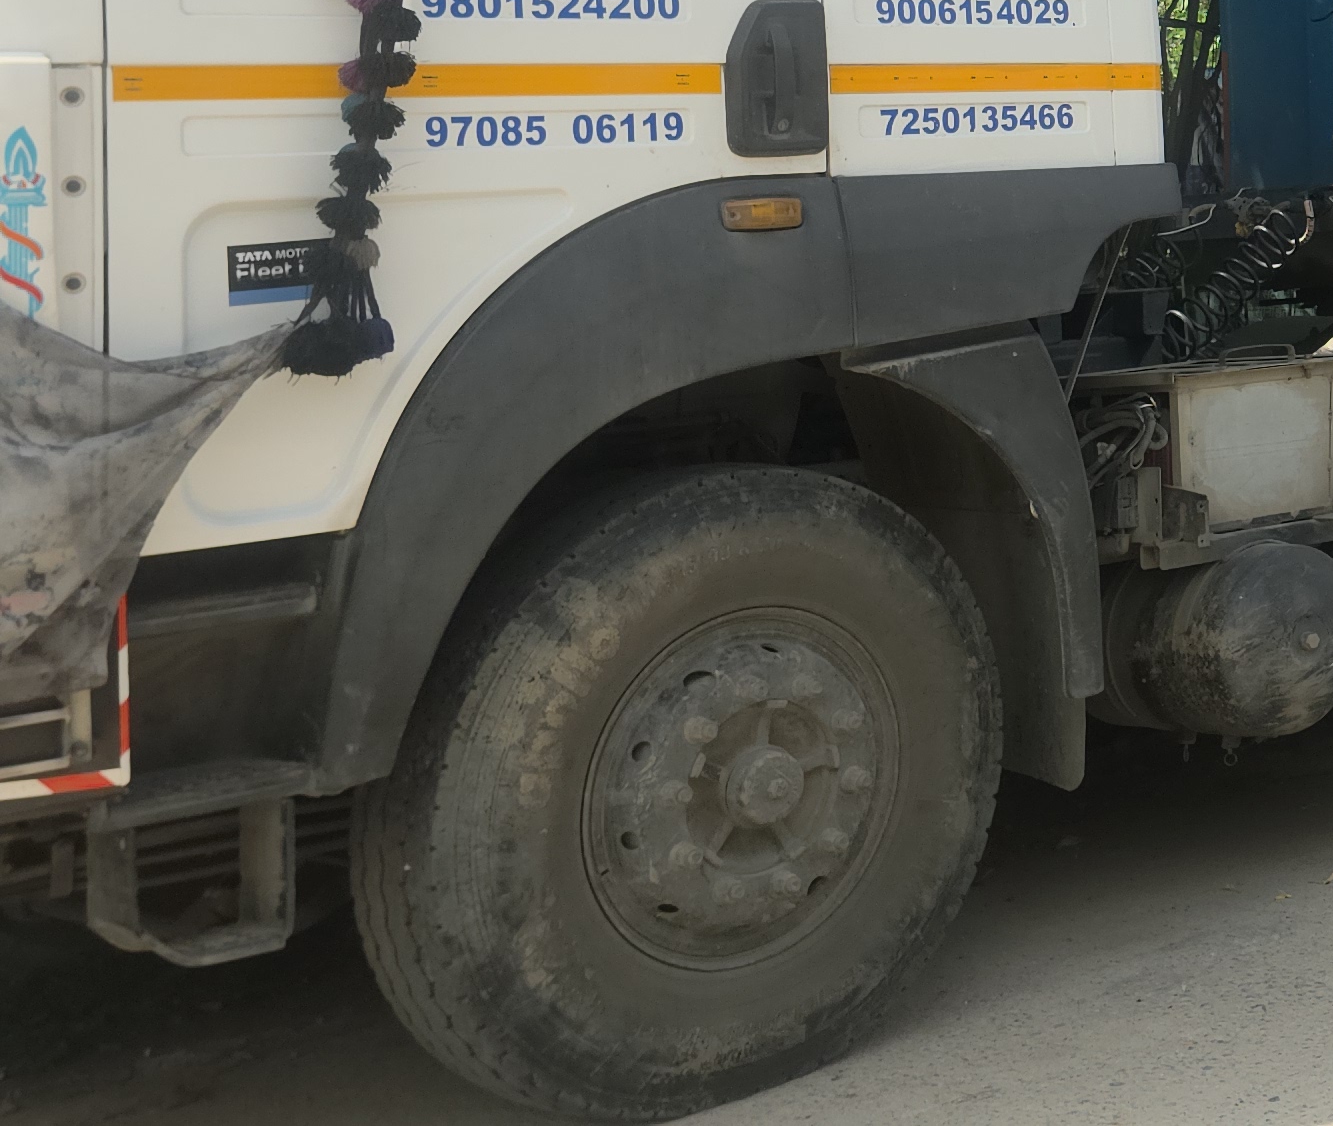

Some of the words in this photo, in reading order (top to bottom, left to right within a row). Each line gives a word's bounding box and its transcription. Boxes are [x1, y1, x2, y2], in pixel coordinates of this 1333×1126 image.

[425, 115, 548, 148] 97085
[572, 112, 684, 145] 06119
[879, 103, 1074, 136] 7250135466
[235, 250, 273, 263] TATA
[235, 261, 293, 282] Fleet
